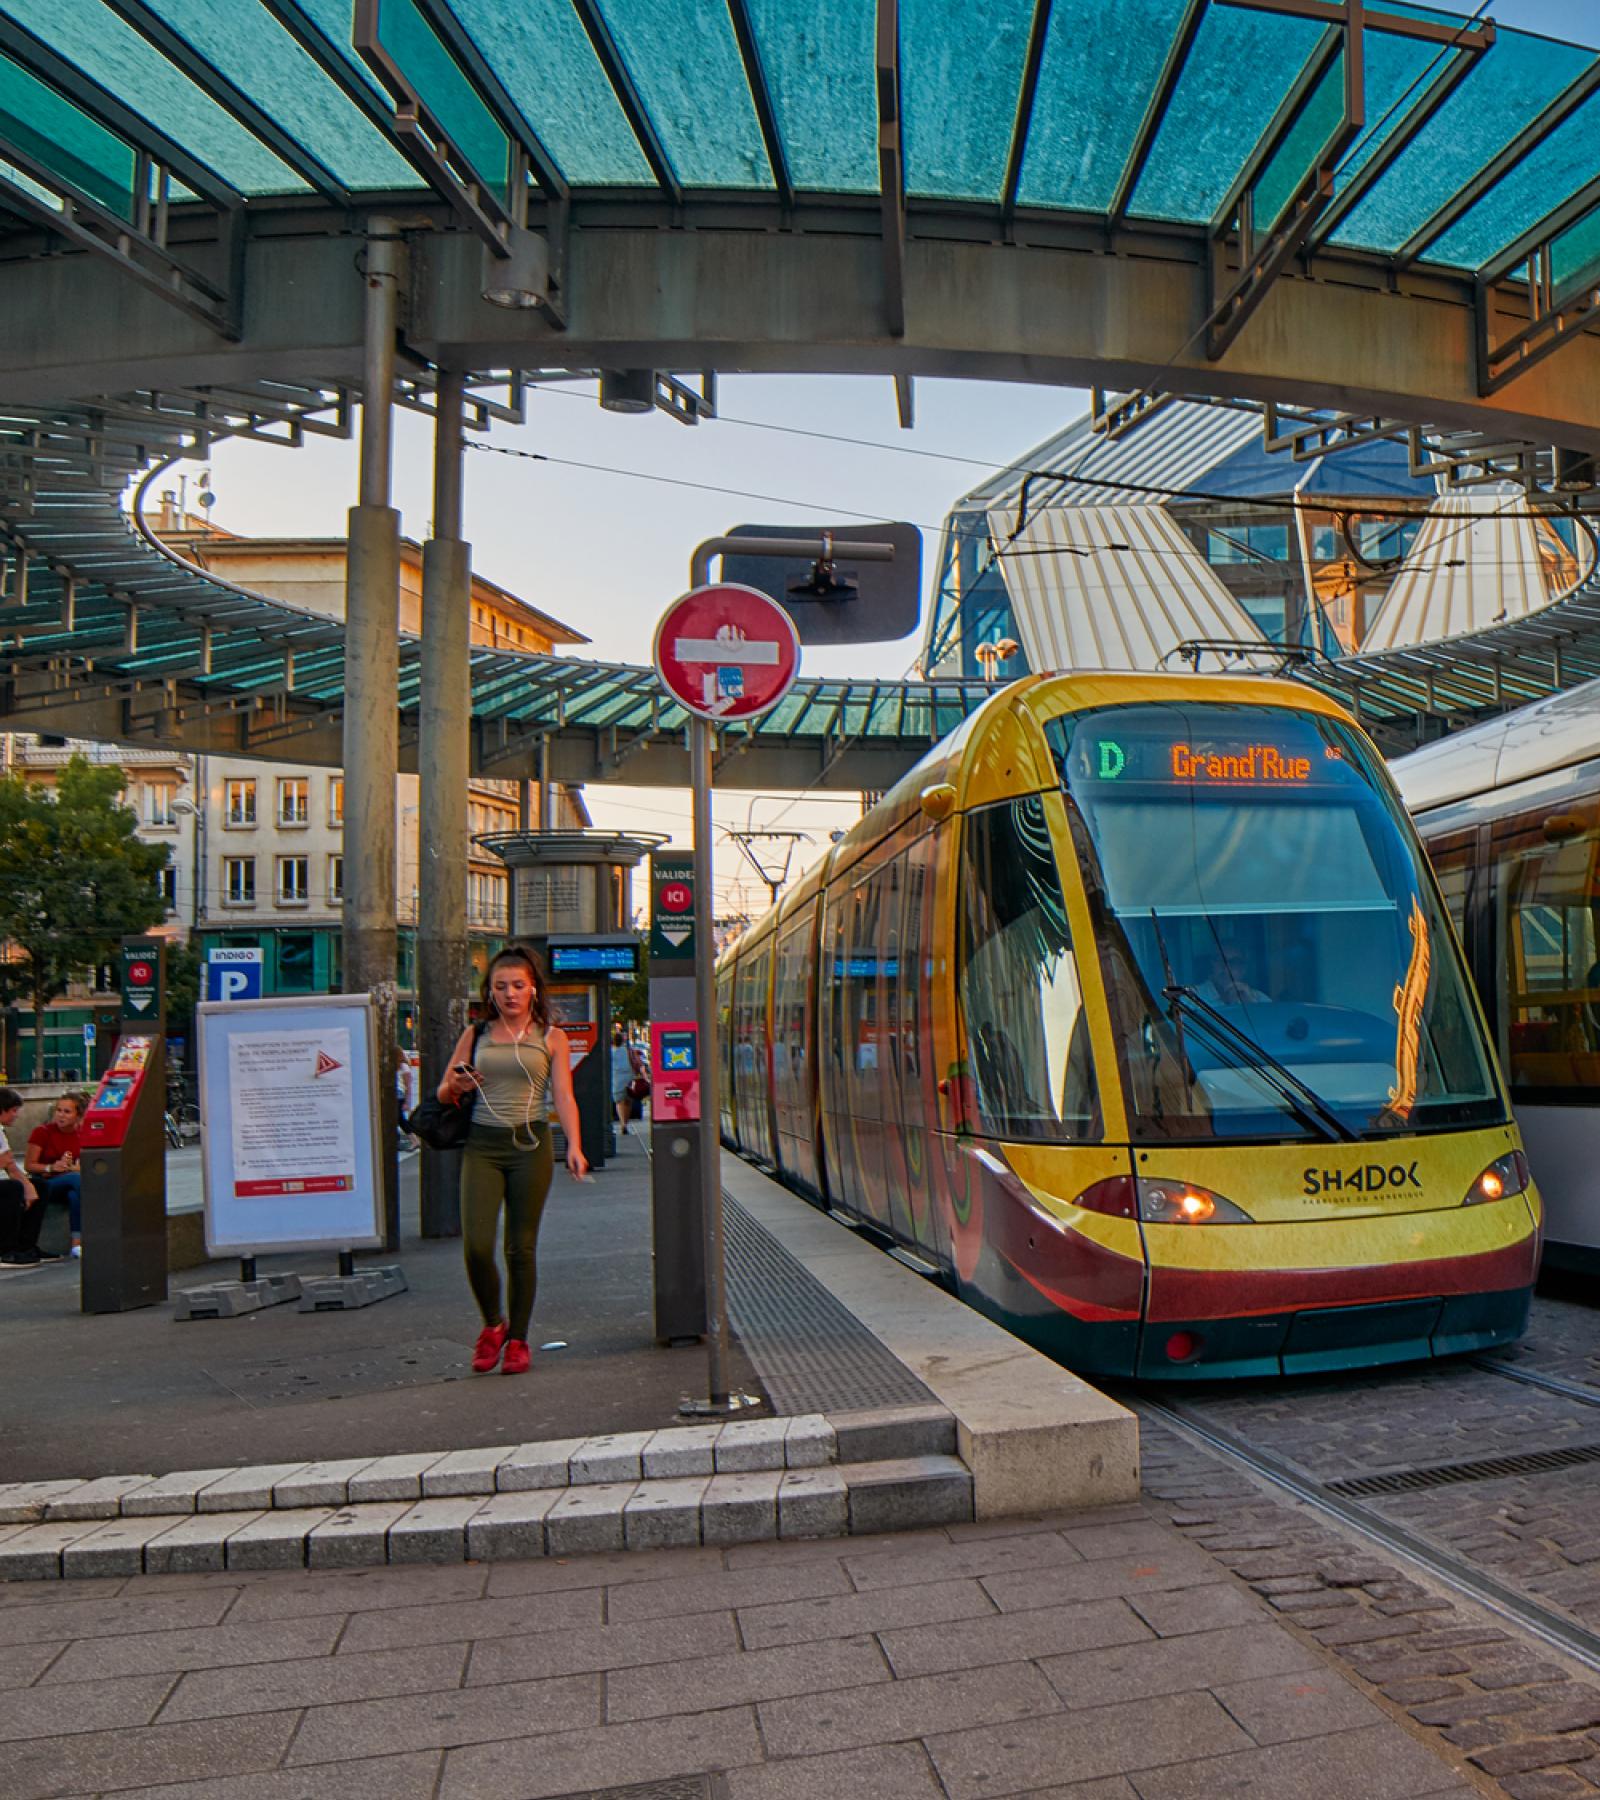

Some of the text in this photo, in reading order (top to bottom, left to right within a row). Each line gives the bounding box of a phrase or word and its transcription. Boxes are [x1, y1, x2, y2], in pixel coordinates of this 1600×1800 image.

[1099, 741, 1311, 779] D Grand'Rue
[667, 891, 684, 903] ICI
[221, 971, 248, 1001] P
[1303, 1161, 1422, 1195] SHADOK
